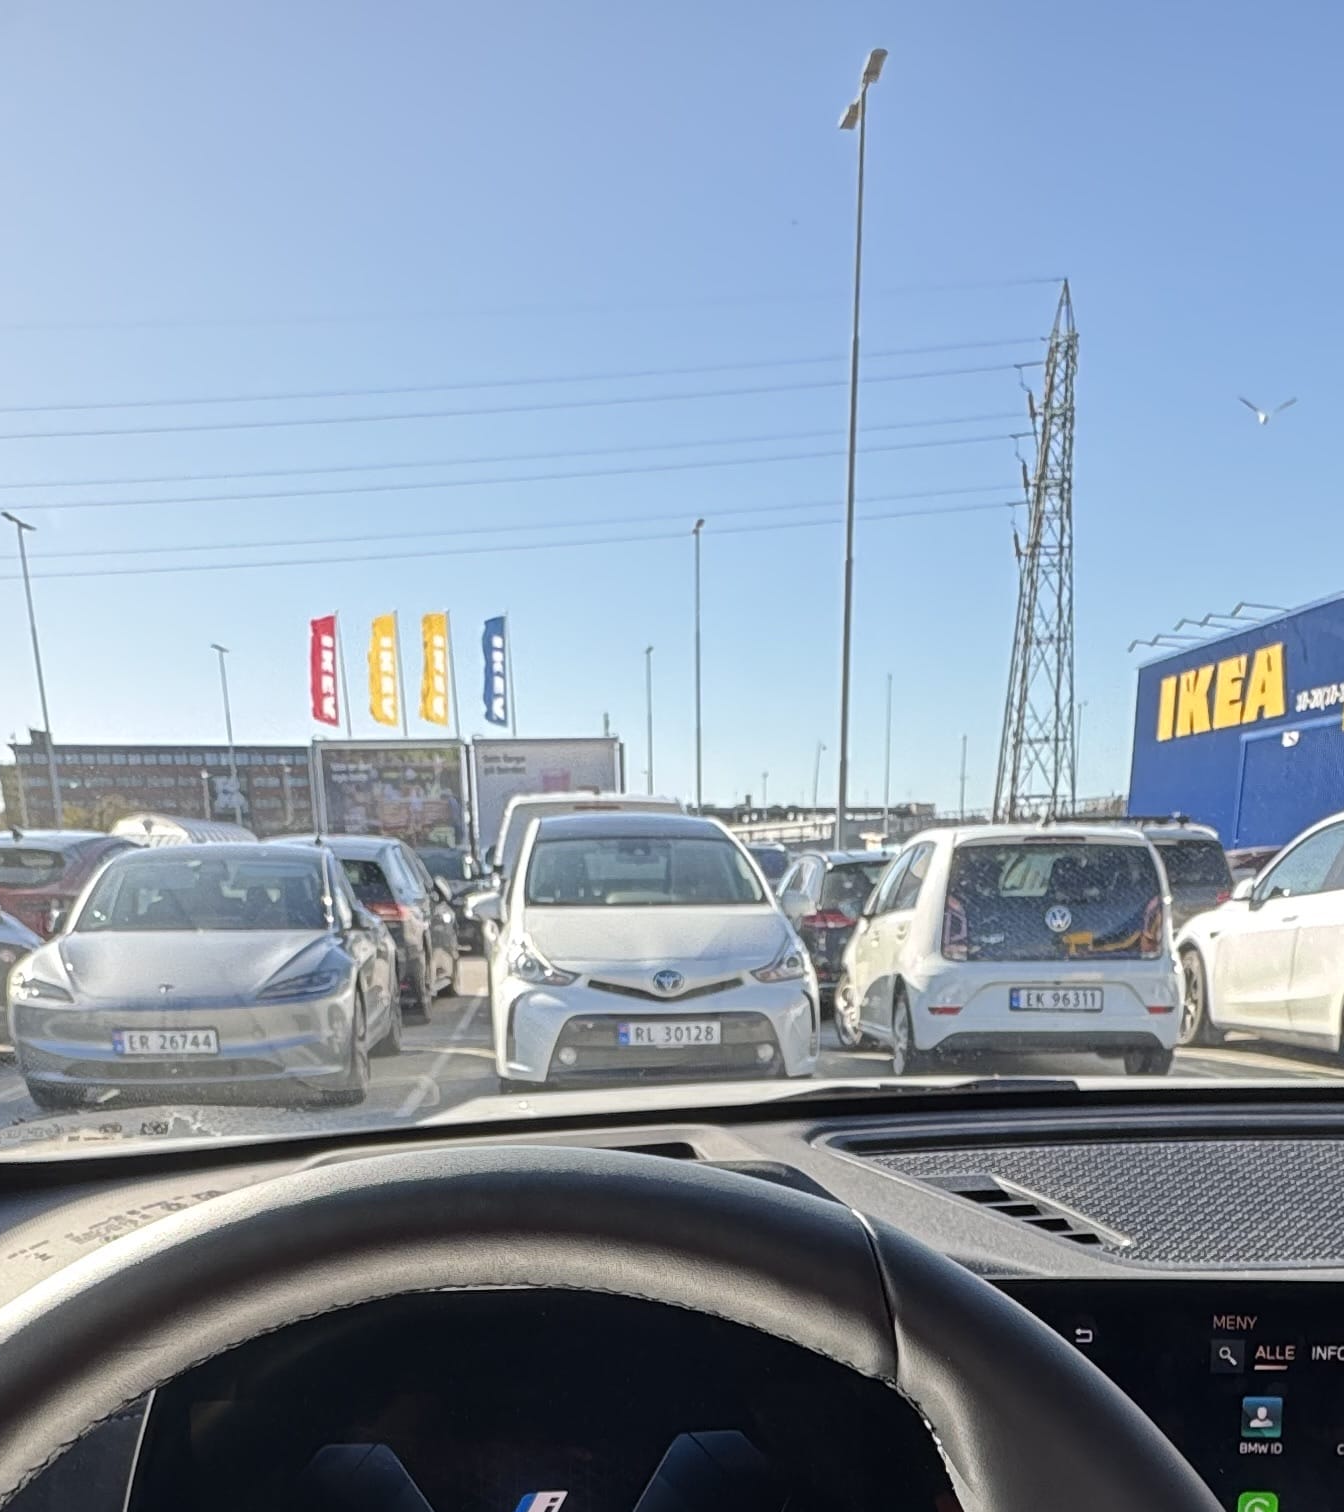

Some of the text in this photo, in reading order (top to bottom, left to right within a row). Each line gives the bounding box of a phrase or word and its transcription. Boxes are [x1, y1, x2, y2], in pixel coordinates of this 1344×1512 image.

[1156, 641, 1286, 743] IKEA
[1027, 992, 1096, 1007] EK 96311
[128, 1032, 212, 1050] ER 26744
[636, 1026, 714, 1042] RL 30128
[1213, 1316, 1256, 1330] MENY
[1256, 1345, 1295, 1360] ALLE
[1239, 1442, 1283, 1454] BMW ID
